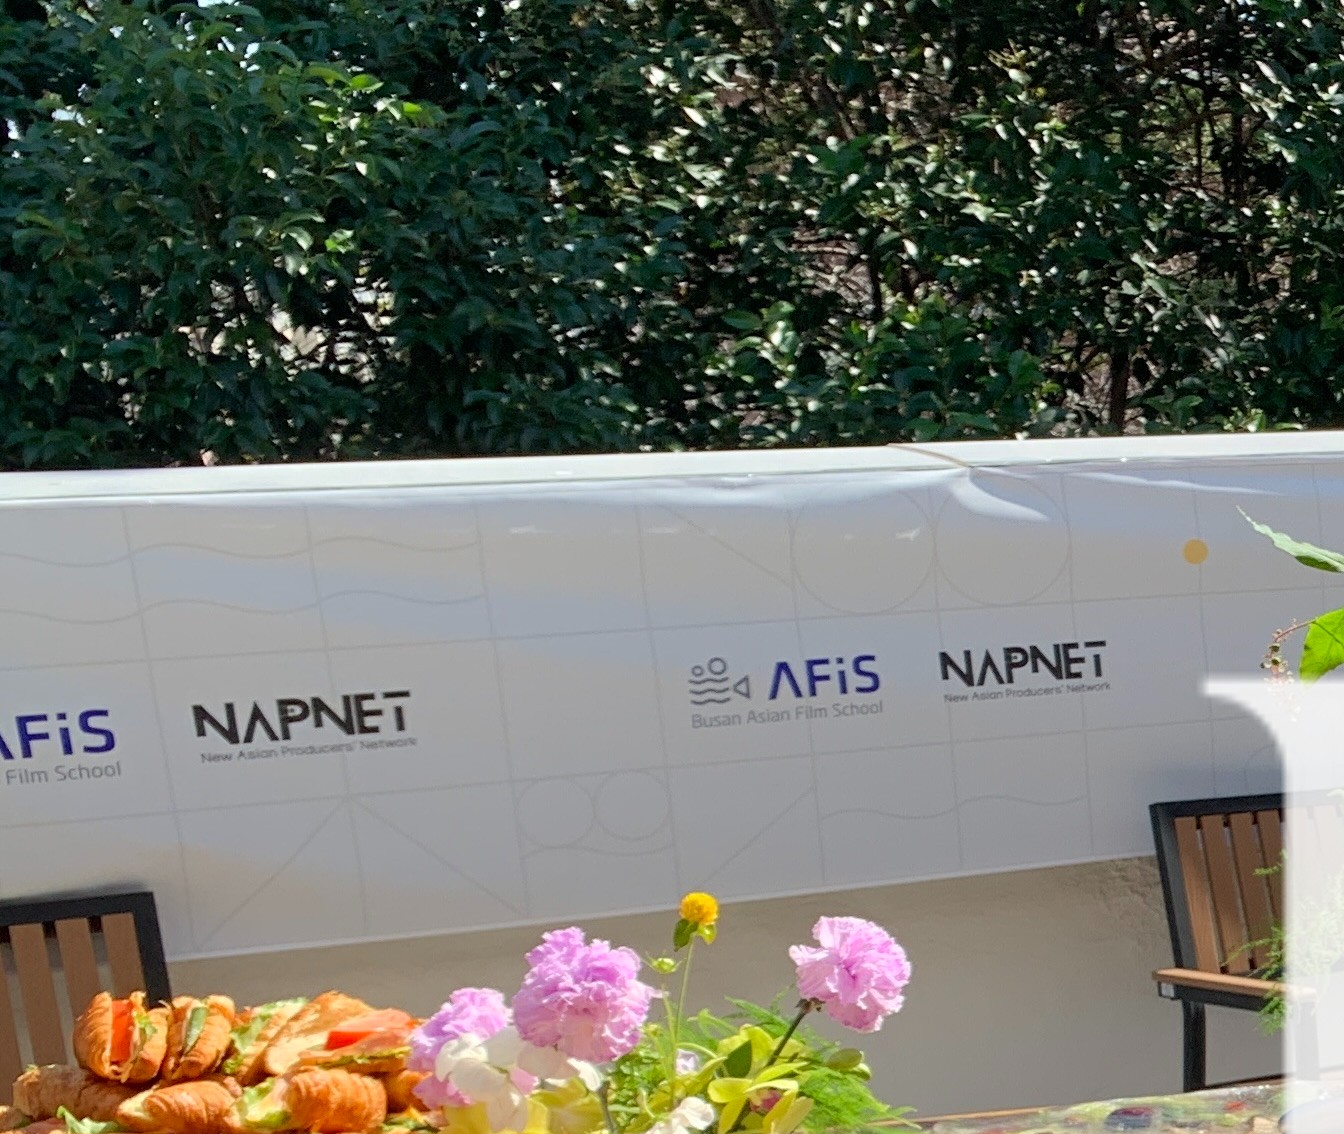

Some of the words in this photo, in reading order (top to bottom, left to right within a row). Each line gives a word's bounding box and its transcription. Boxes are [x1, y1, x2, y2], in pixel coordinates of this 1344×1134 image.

[769, 655, 881, 700] AFiS
[938, 640, 1107, 688] NAPNET
[943, 692, 969, 703] New
[971, 689, 1004, 702] Asian
[1066, 681, 1111, 694] Network
[191, 690, 411, 745] NAPNET
[691, 712, 742, 729] Busan
[747, 708, 791, 724] Asian
[795, 704, 828, 720] Film
[832, 700, 884, 718] School
[200, 751, 233, 764] New
[237, 746, 278, 761] Asian
[359, 736, 418, 751] Network
[5, 767, 49, 785] Film
[54, 760, 122, 782] School
